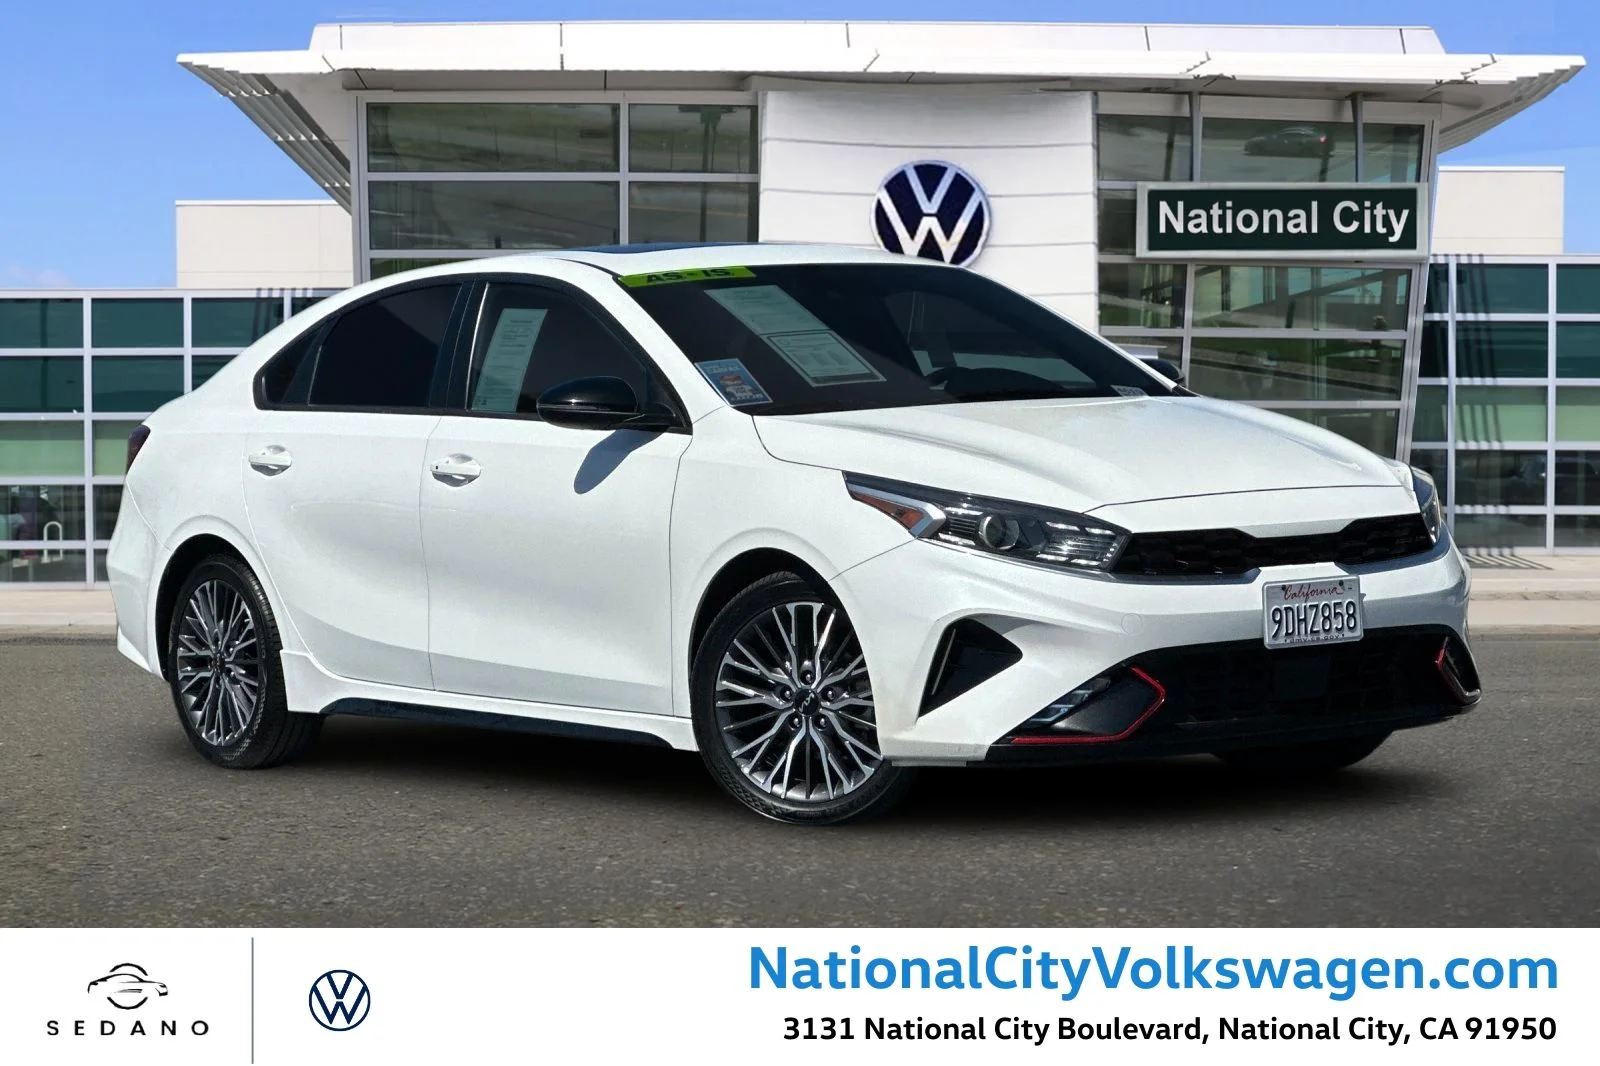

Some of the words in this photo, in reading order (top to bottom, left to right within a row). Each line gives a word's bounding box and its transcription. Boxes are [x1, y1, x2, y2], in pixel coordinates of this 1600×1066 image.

[1159, 200, 1318, 234] National
[1333, 200, 1410, 243] City
[1284, 583, 1344, 602] California
[1271, 600, 1358, 639] 9DHZ858
